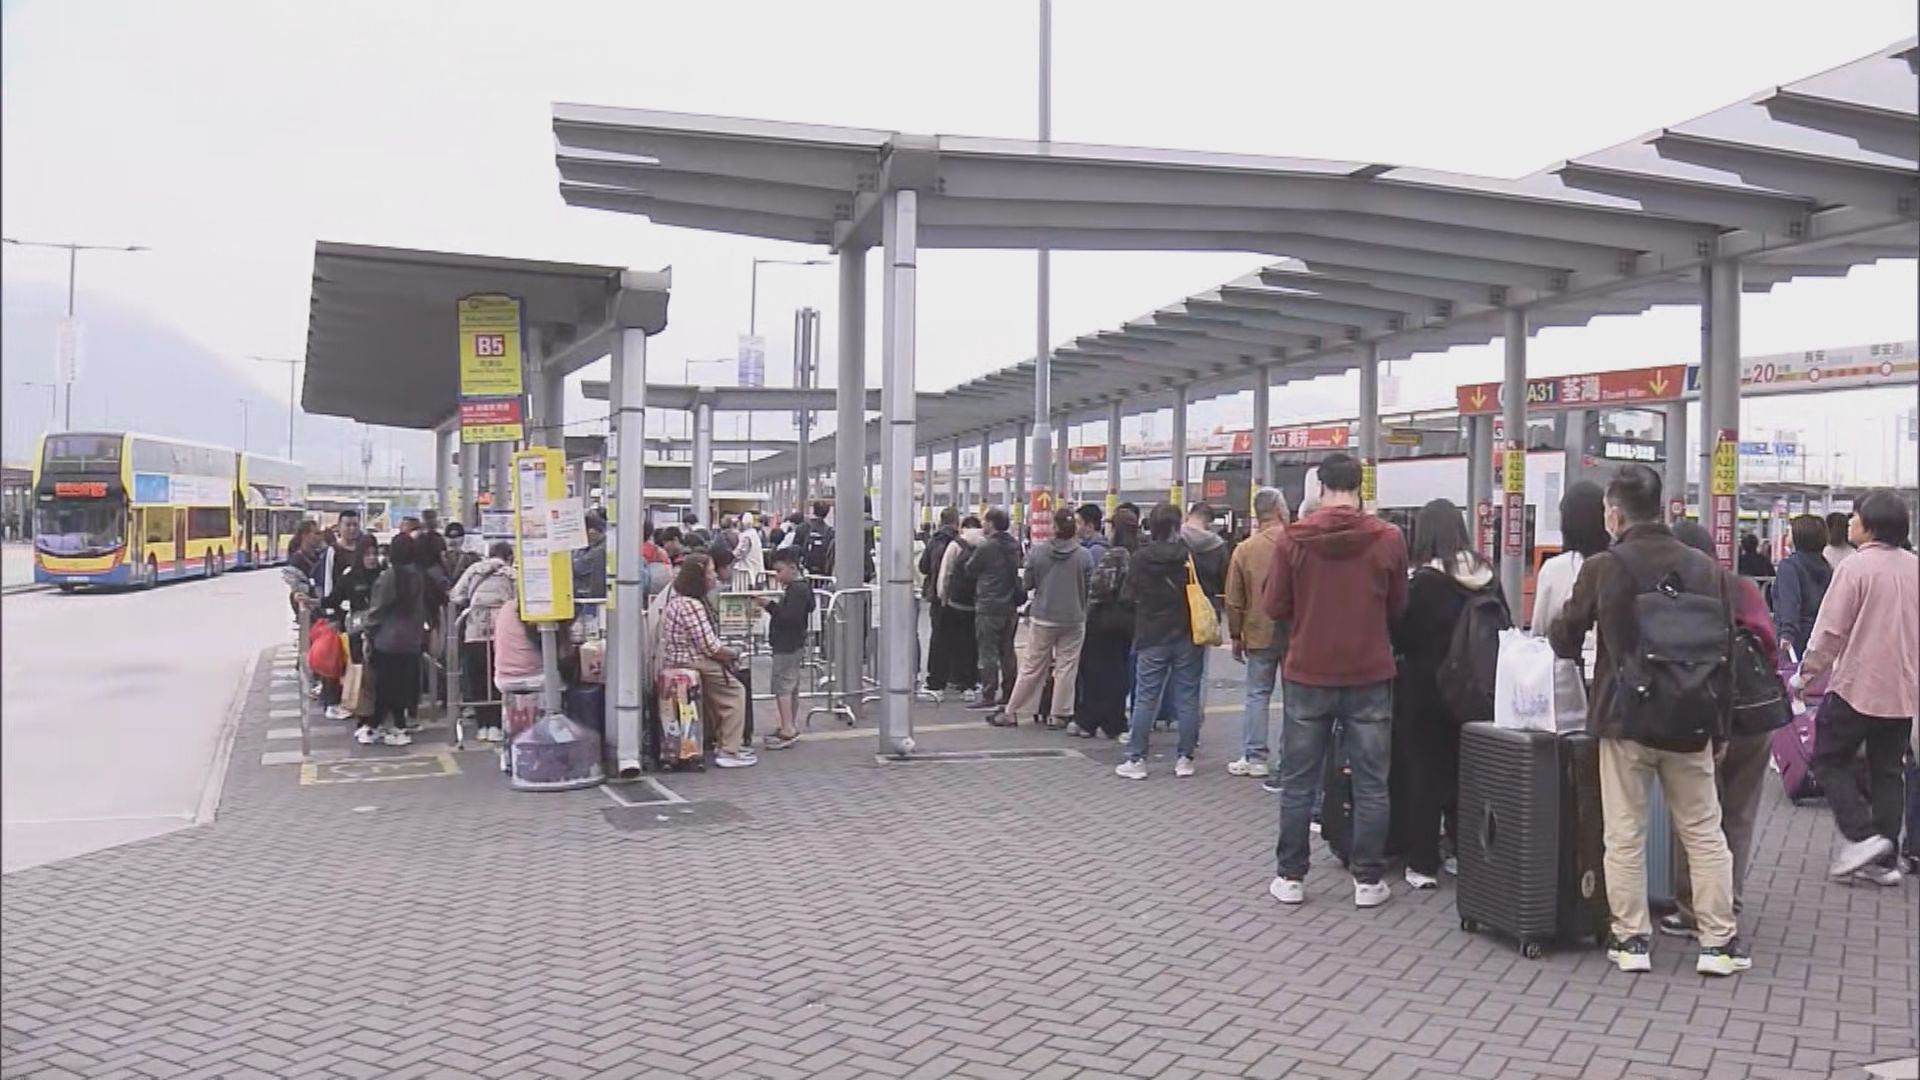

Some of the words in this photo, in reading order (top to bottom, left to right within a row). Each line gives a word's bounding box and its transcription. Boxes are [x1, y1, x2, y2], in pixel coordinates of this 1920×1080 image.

[478, 336, 504, 356] B5
[1753, 363, 1775, 383] 20
[1527, 382, 1554, 403] A31
